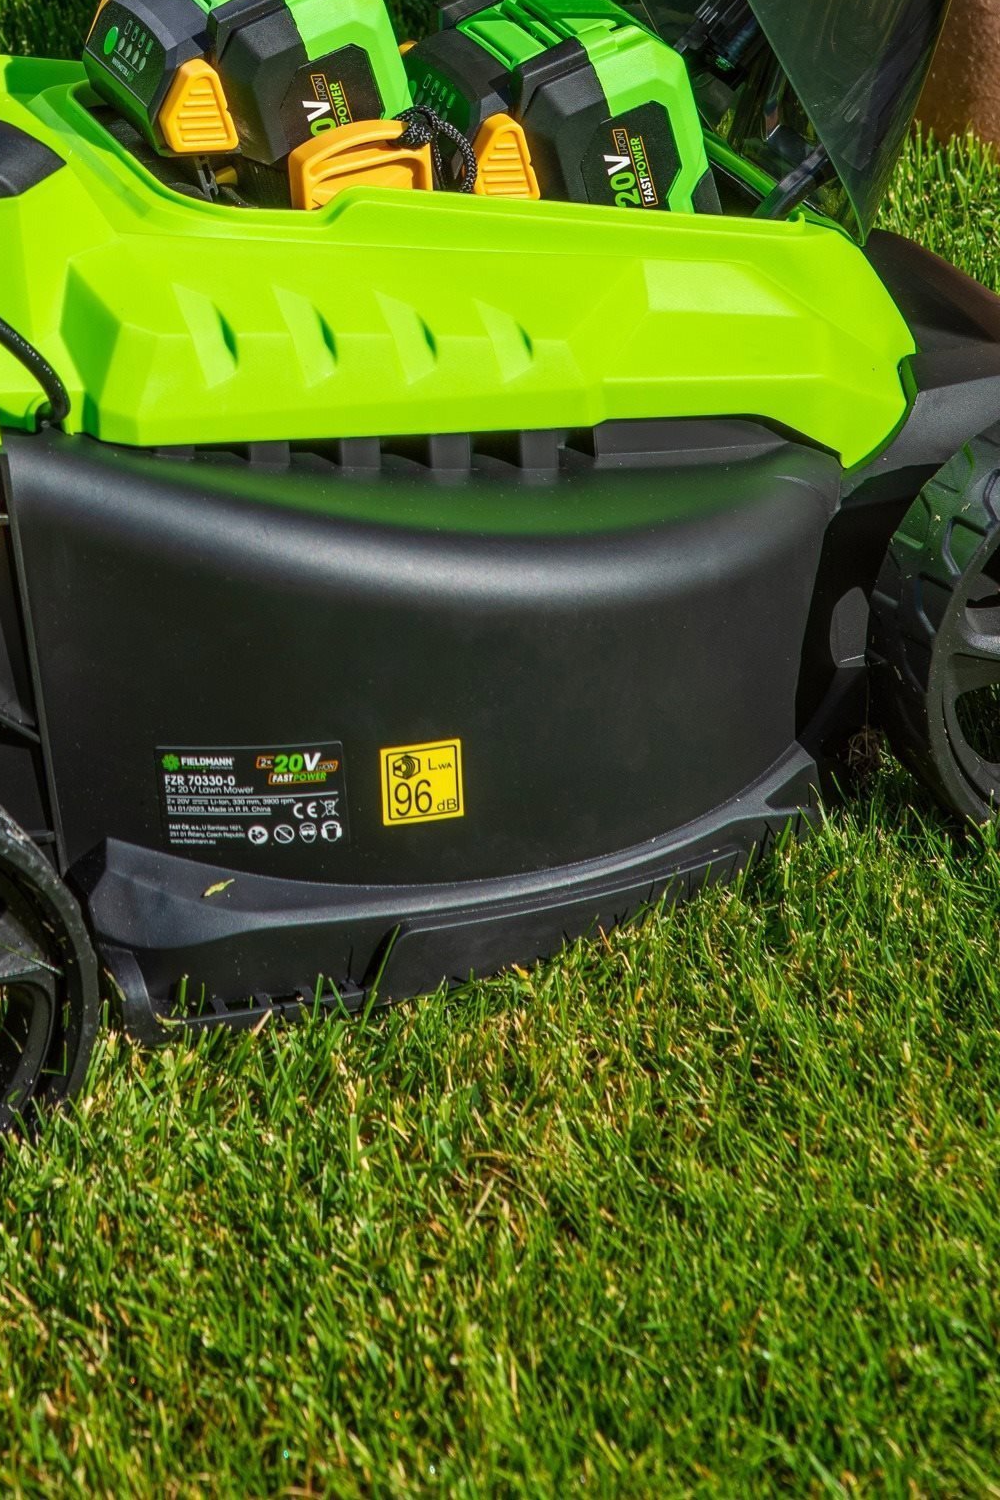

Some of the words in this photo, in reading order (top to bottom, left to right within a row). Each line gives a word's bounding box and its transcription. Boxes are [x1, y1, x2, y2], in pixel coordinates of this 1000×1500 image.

[603, 154, 641, 208] 20V
[181, 757, 233, 766] FIELDMANN
[274, 752, 321, 774] 20V
[164, 774, 184, 786] FZR
[188, 775, 236, 786] 70330-0
[178, 786, 188, 794] 20
[190, 786, 197, 794] V
[198, 786, 222, 794] Lawn
[224, 786, 254, 794] Mower
[394, 779, 432, 816] 96
[437, 798, 457, 812] dB
